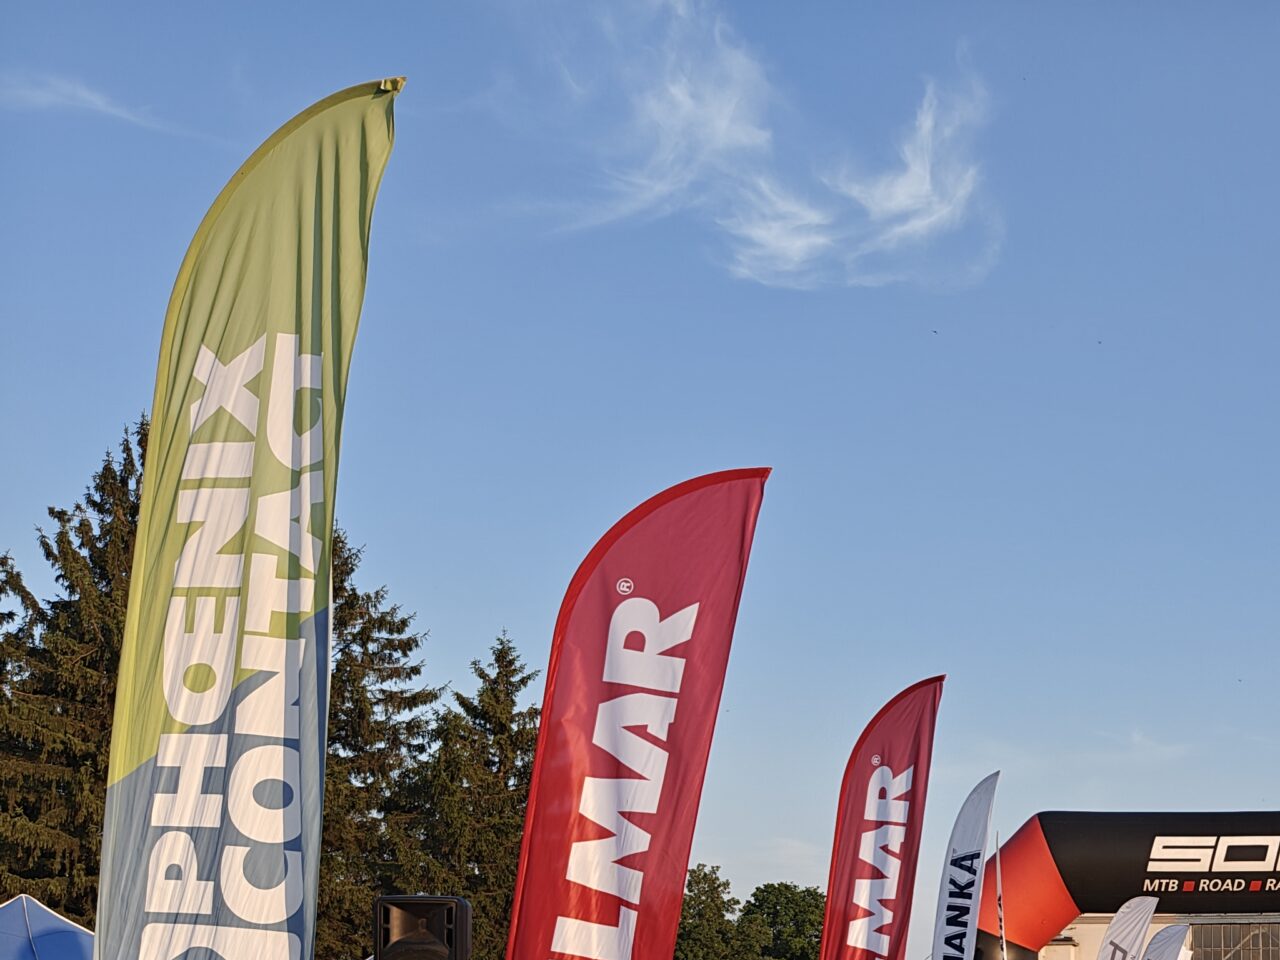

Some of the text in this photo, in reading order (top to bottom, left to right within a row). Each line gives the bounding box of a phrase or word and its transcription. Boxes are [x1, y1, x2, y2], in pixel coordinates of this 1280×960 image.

[145, 332, 267, 915] PHOENIX
[1143, 878, 1179, 892] MTB
[1199, 877, 1246, 892] ROAD
